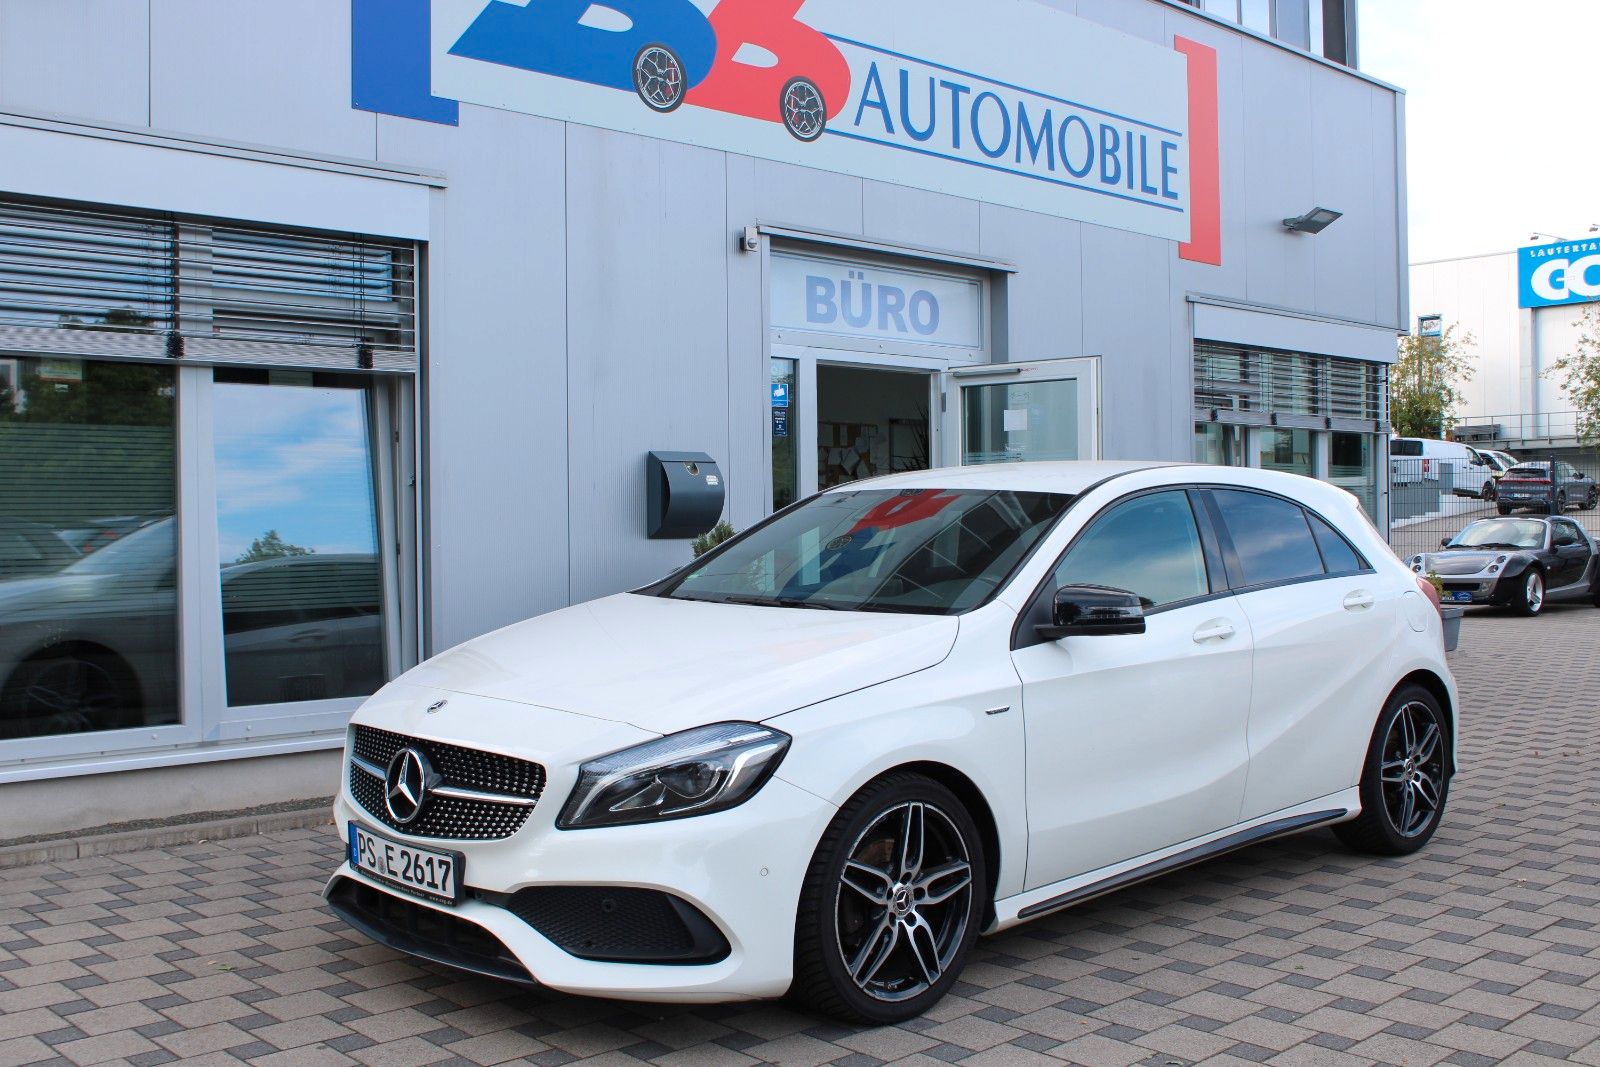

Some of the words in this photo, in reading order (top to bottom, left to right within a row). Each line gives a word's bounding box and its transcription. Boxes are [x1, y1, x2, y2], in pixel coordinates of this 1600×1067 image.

[854, 61, 1179, 200] AUTOMOBILE
[1529, 242, 1600, 258] LAUTERTA
[805, 271, 940, 335] BÜRO
[357, 831, 377, 868] PS
[385, 844, 398, 877] E
[401, 849, 451, 892] 2617
